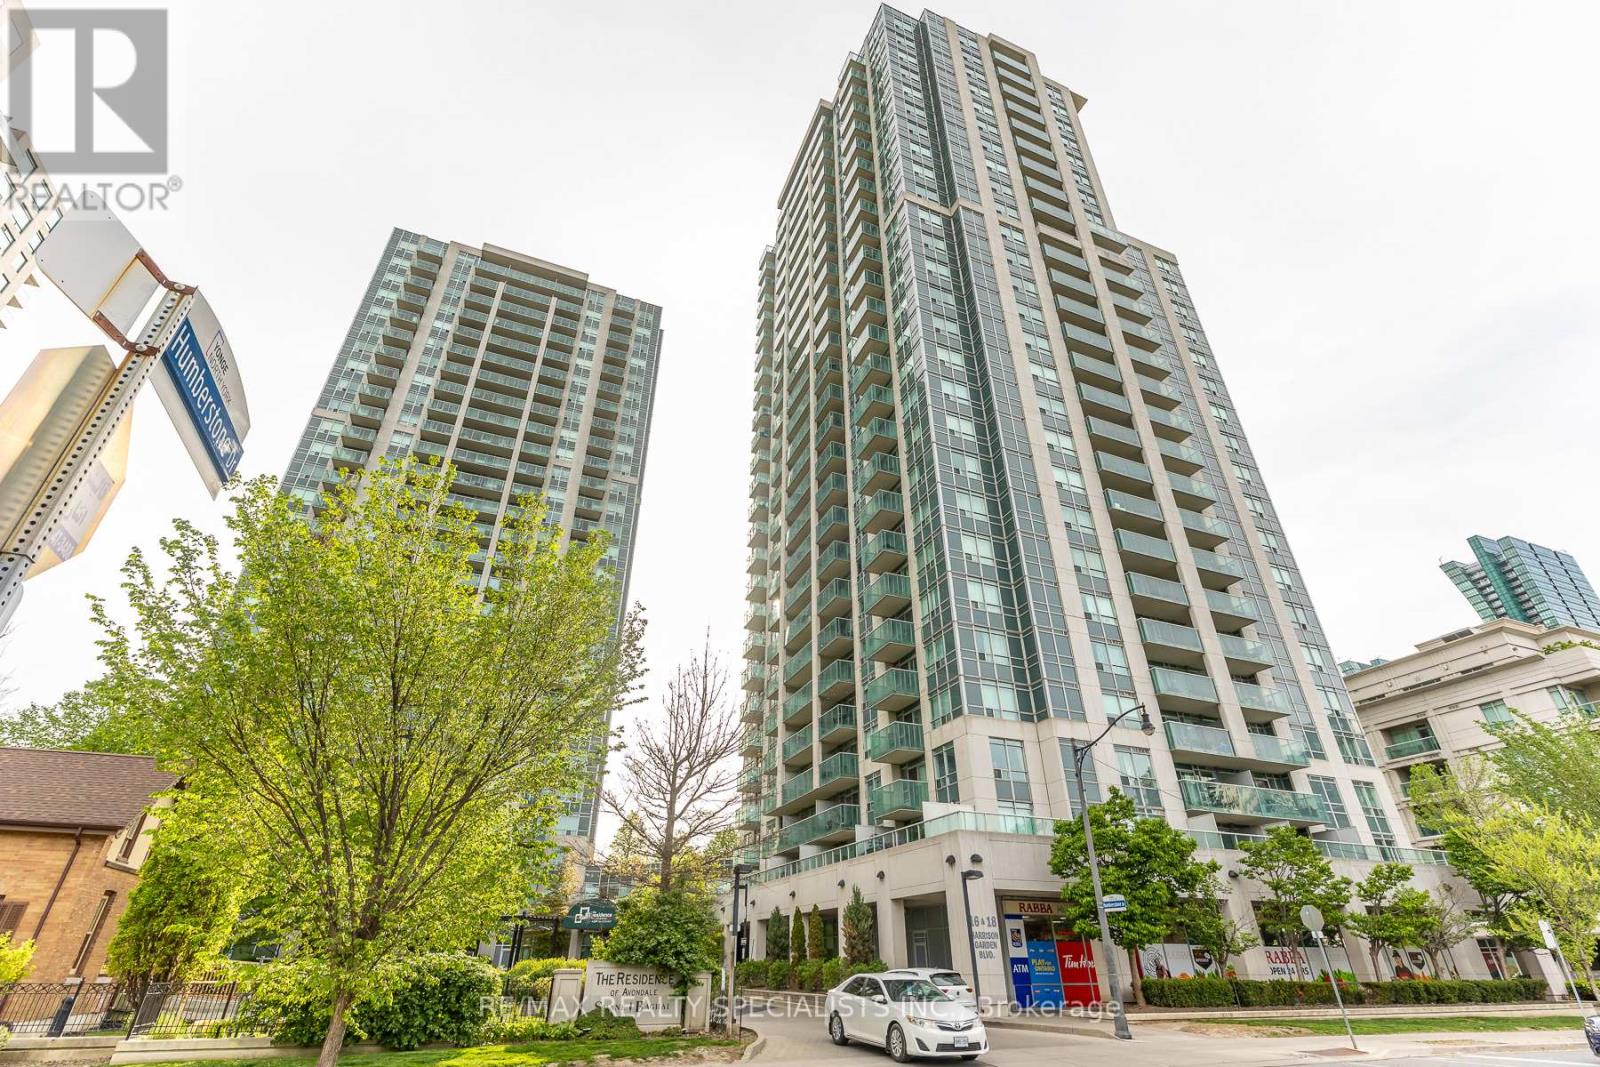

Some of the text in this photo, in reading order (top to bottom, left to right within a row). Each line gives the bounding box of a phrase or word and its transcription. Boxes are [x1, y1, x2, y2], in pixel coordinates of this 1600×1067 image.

[213, 341, 228, 376] YONGE
[1018, 902, 1054, 914] RABBA
[986, 915, 997, 927] 18
[972, 931, 999, 940] ARRISON
[1062, 954, 1080, 969] Tim
[1012, 963, 1029, 974] ATM
[596, 971, 616, 986] THE
[622, 987, 657, 997] AVONDALE
